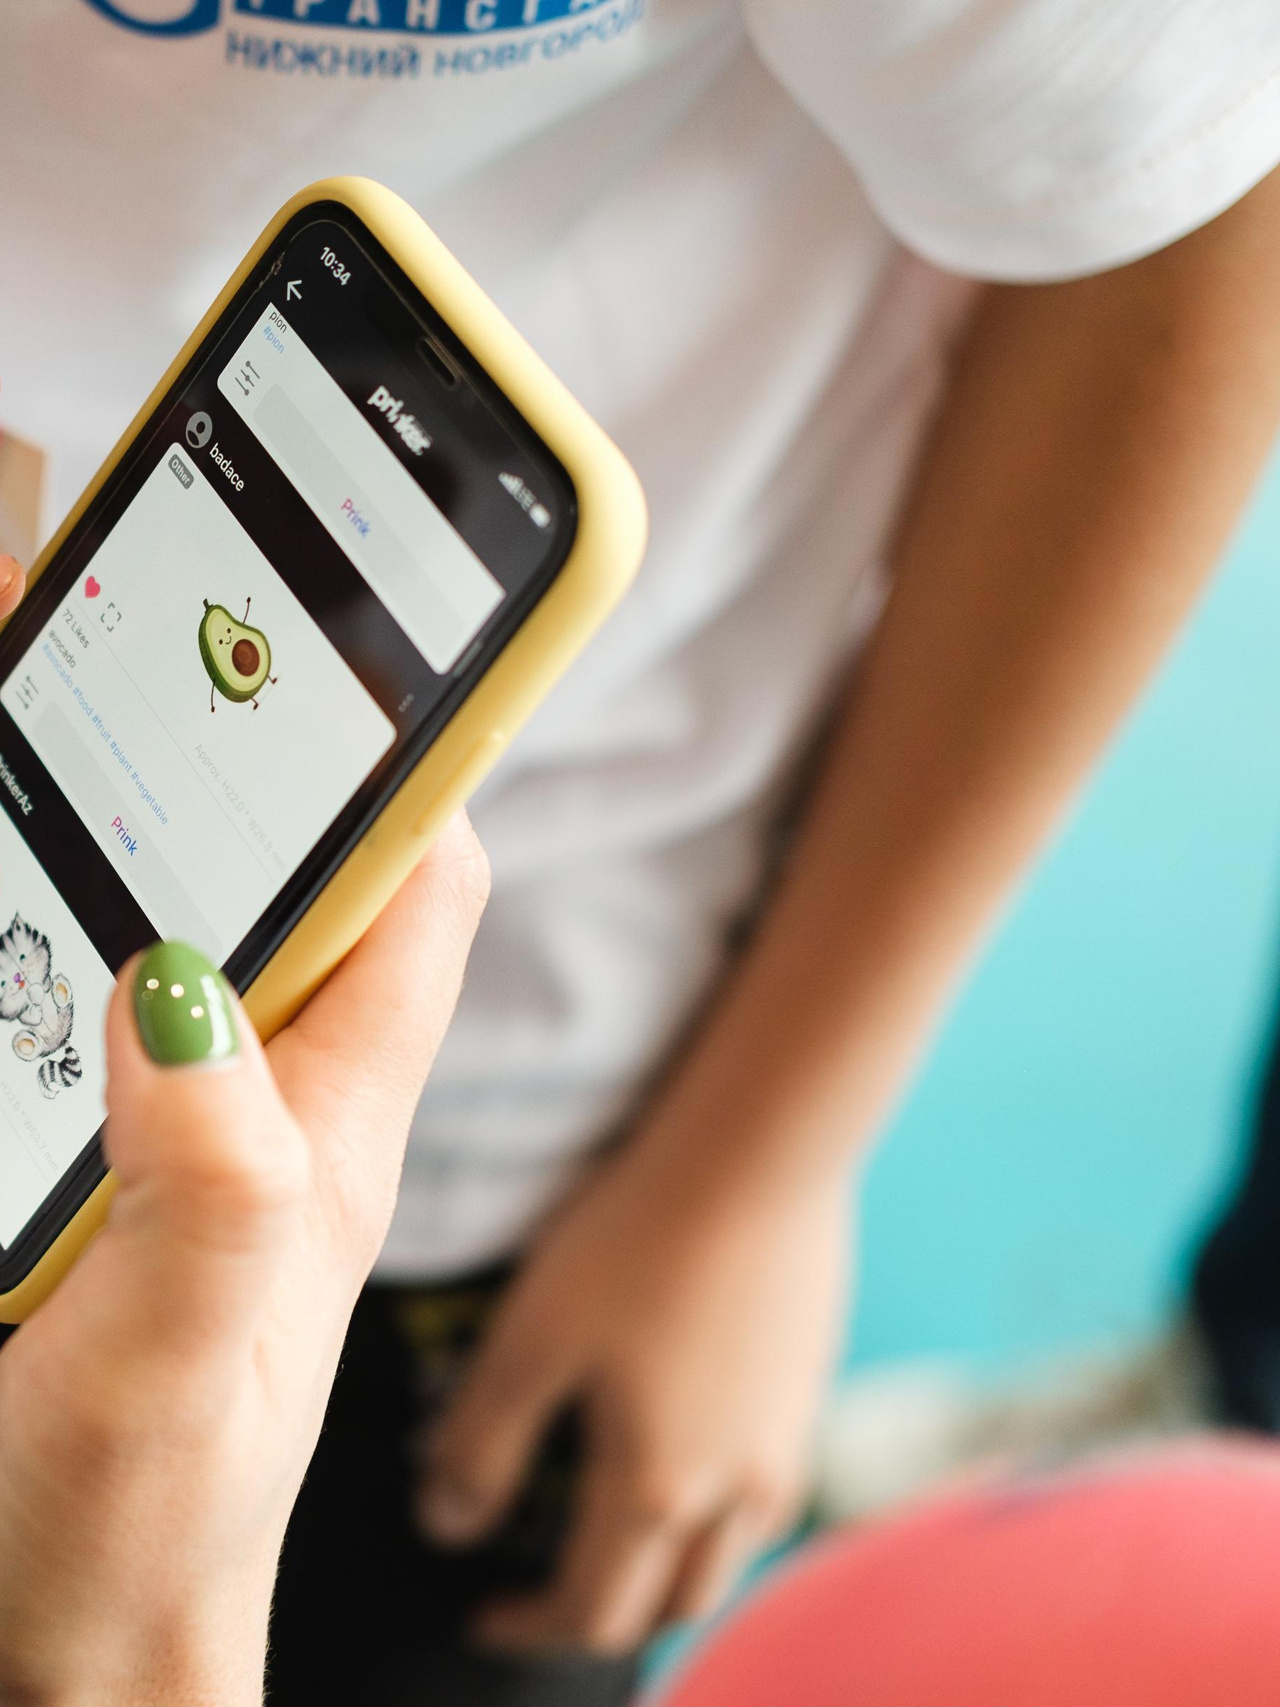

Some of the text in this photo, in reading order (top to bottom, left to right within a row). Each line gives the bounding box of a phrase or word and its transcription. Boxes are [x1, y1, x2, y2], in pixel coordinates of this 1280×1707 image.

[320, 246, 352, 286] 10:34
[263, 325, 286, 354] #pion
[268, 311, 288, 334] pion
[171, 459, 191, 485] Other
[209, 442, 245, 492] badace
[340, 498, 370, 538] Prink
[62, 608, 90, 649] 72 Likes
[48, 629, 76, 669] avocado
[42, 643, 169, 825] #avocado #food #fruit #plant #vegetable
[111, 815, 138, 857] Prink
